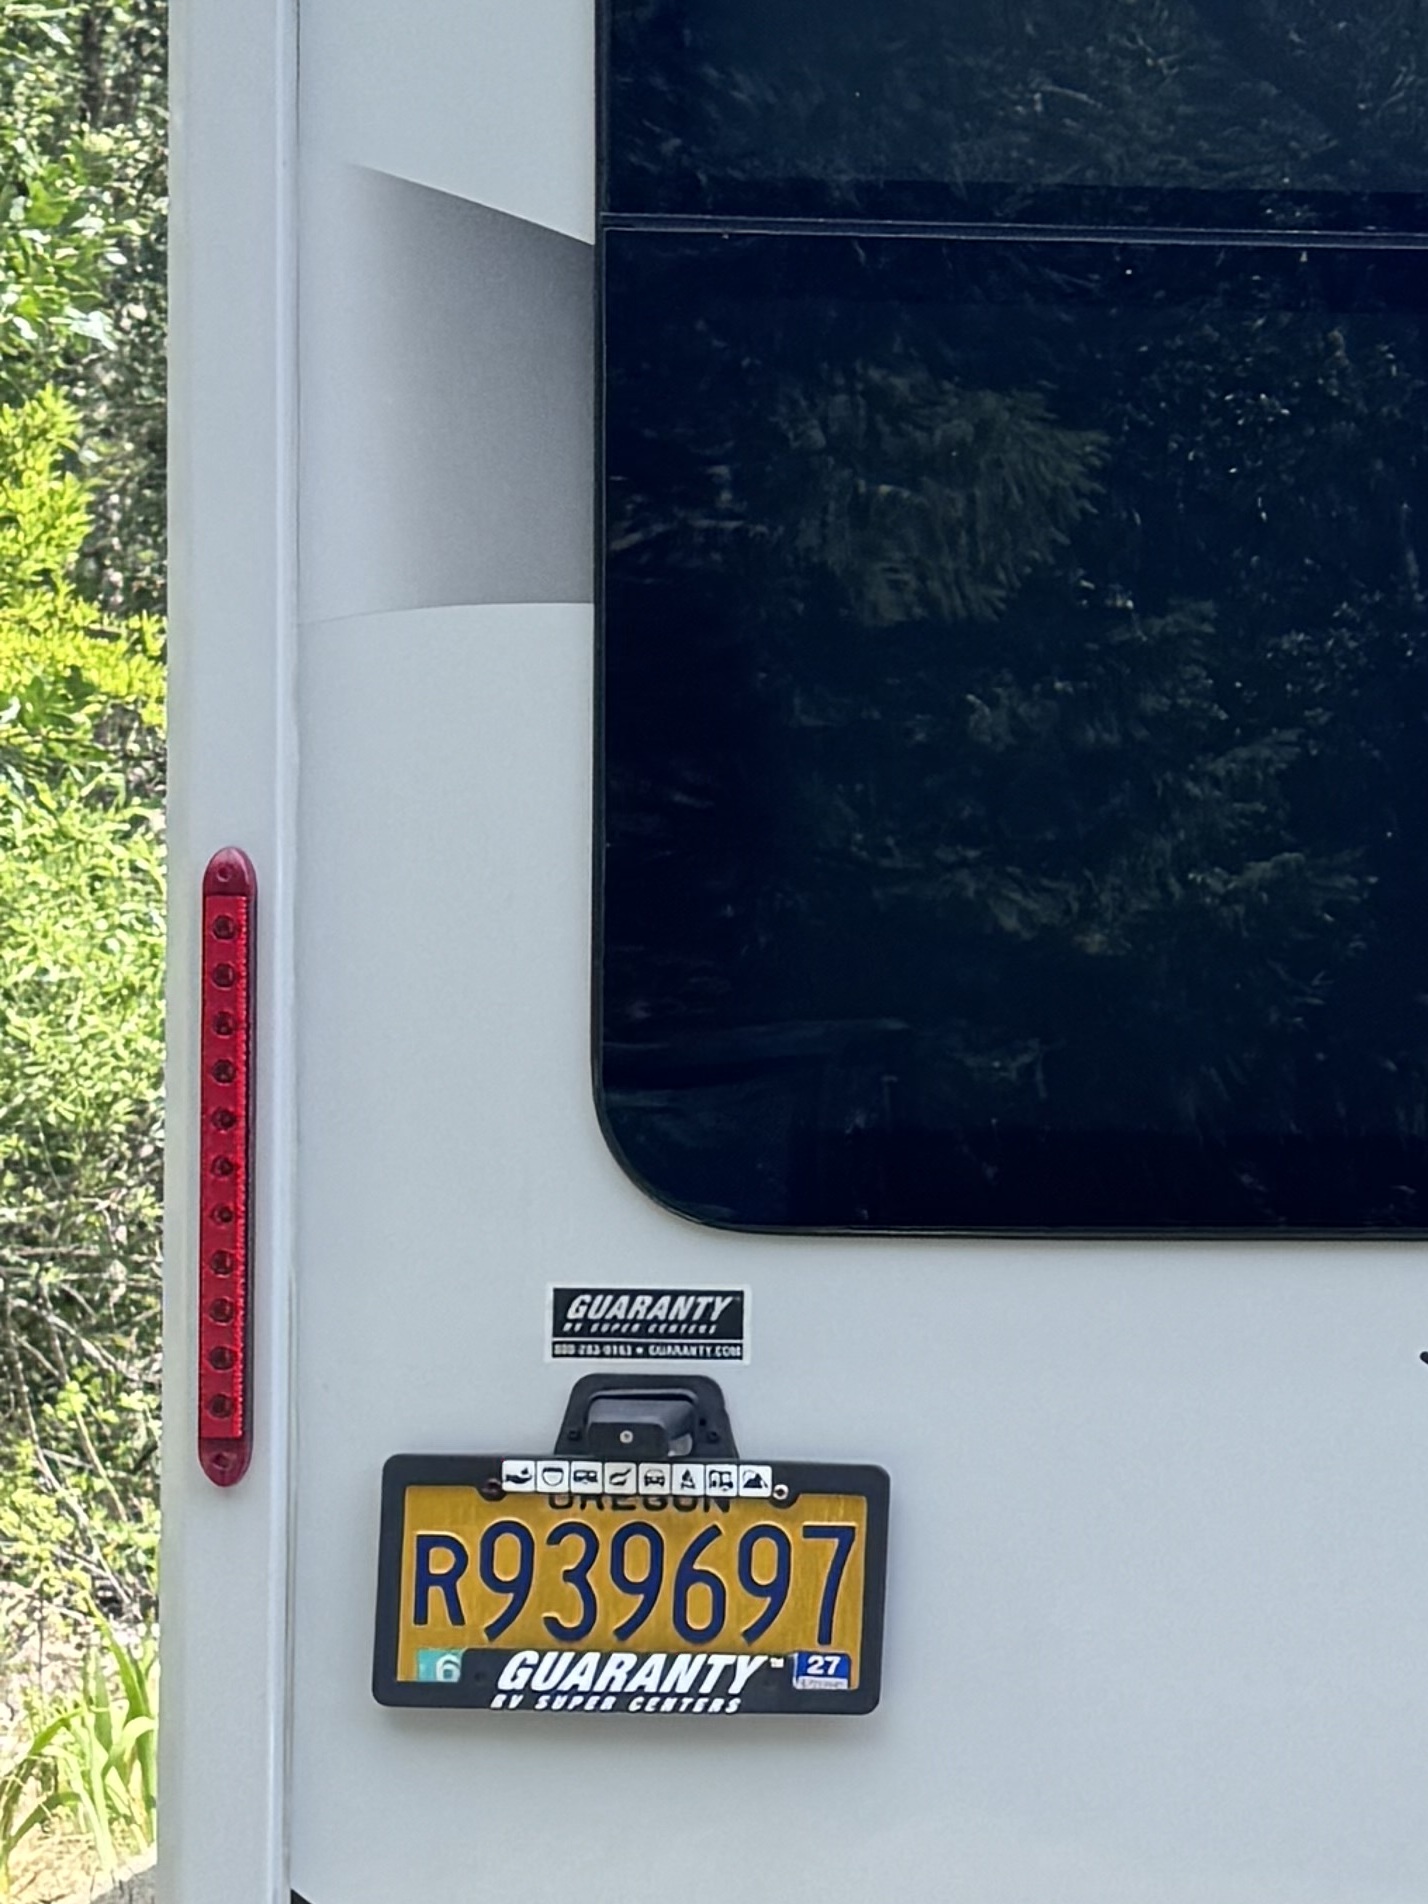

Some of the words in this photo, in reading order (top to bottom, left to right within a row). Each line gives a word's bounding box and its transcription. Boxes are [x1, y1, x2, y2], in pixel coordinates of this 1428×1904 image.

[566, 1294, 734, 1321] GUARANTY
[412, 1520, 858, 1646] R939697
[435, 1653, 462, 1683] 6
[497, 1649, 769, 1695] GUARANTY
[806, 1654, 842, 1676] 27
[490, 1694, 524, 1711] RV
[534, 1694, 616, 1712] SUPER
[628, 1697, 742, 1714] CENTERS
